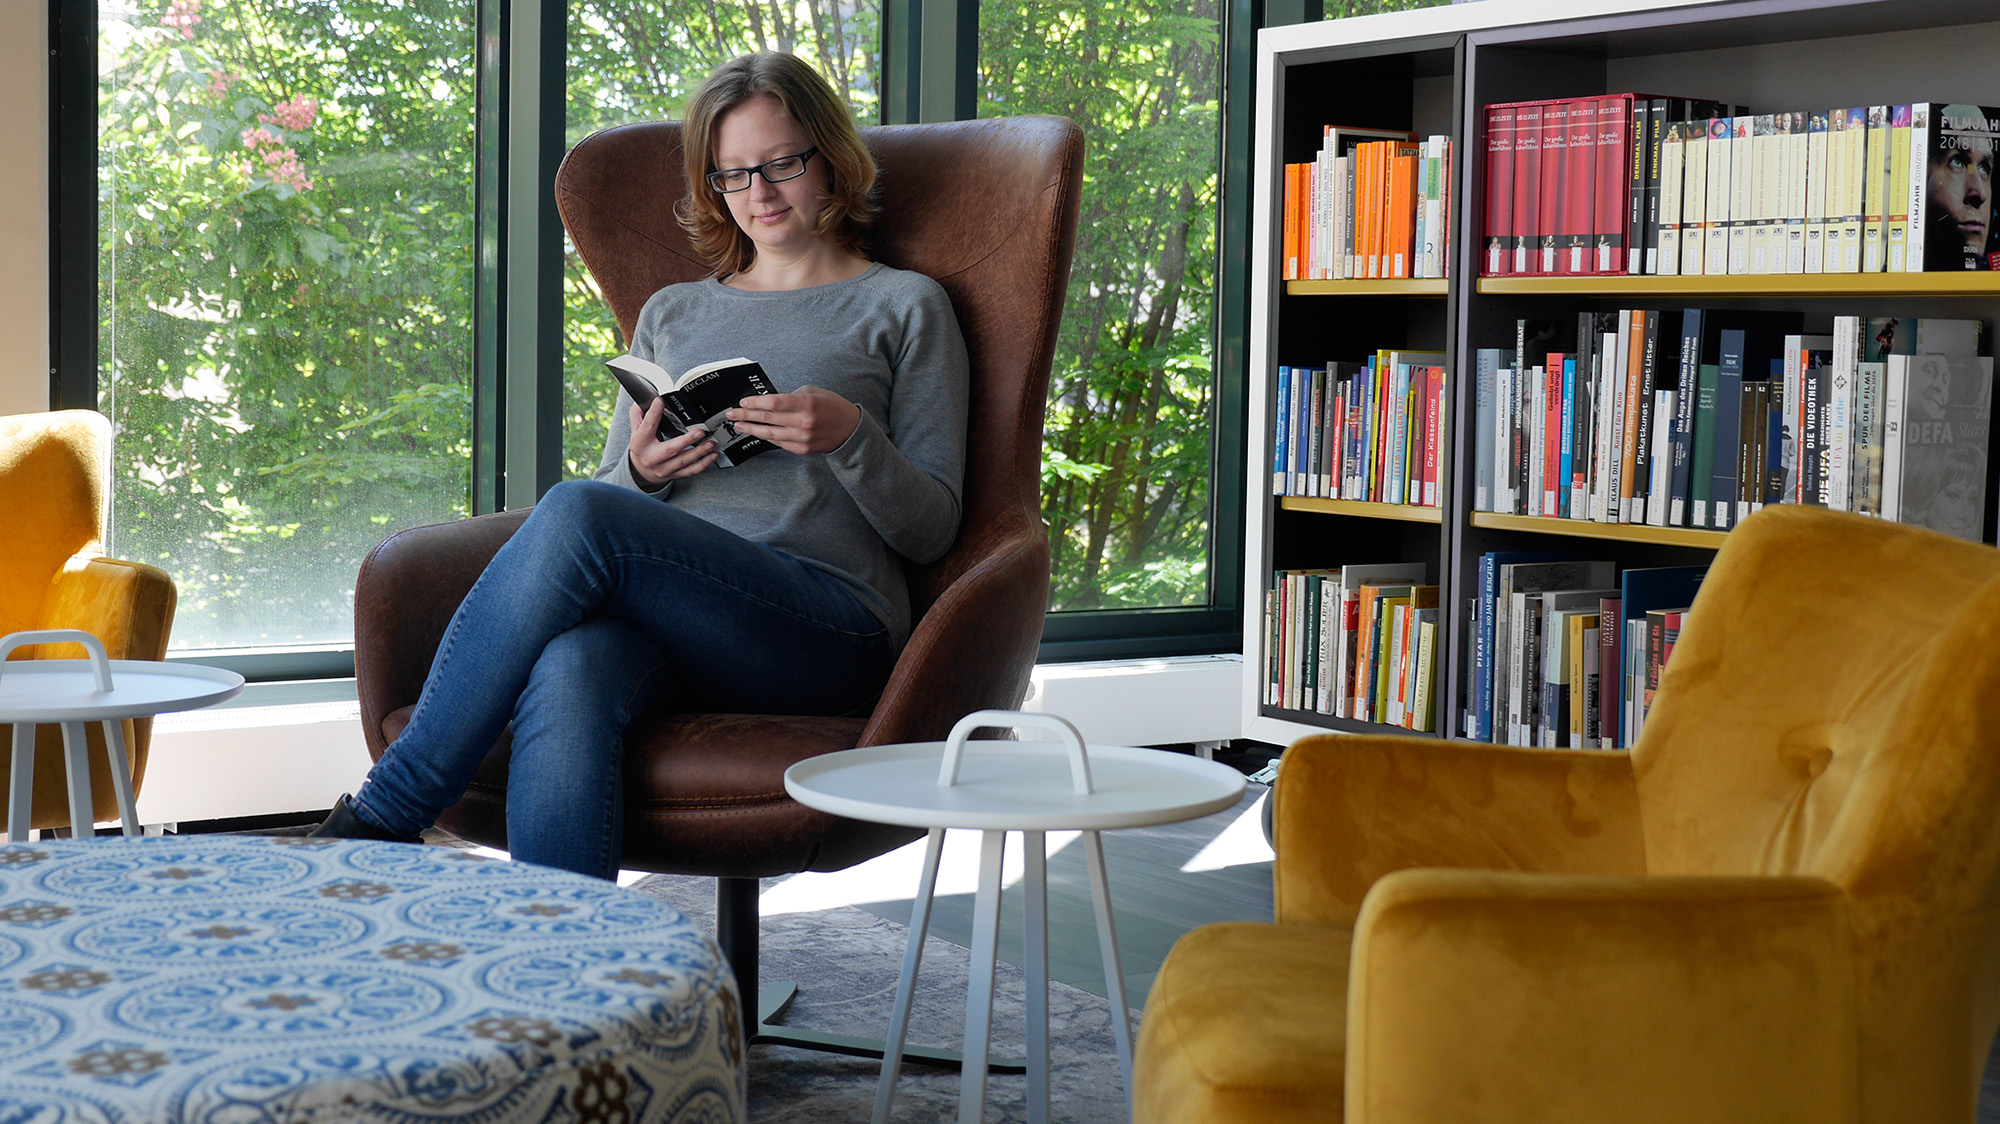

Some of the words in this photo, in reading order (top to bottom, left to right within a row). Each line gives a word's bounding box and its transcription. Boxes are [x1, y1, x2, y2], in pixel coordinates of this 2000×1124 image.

[1942, 116, 2000, 131] FILMJAH
[1682, 337, 1690, 362] Reiches
[1517, 358, 1523, 366] IM
[683, 372, 720, 392] RECLAM
[1642, 369, 1651, 395] Ernst
[1680, 365, 1688, 386] Dritten
[1863, 371, 1871, 399] FILME
[1553, 371, 1561, 405] verdrängt
[1615, 392, 1623, 407] Kino
[1626, 376, 1637, 433] Filmplakate
[1808, 378, 1816, 429] VIDEOTHEK
[1614, 410, 1622, 425] fürs
[1835, 397, 1844, 428] Farbe
[1428, 399, 1436, 450] Klassenfeind
[1637, 403, 1648, 464] Plakatkunst
[1908, 422, 1953, 444] DEFA
[1613, 429, 1621, 449] Kunst
[1624, 436, 1634, 458] 700
[1807, 433, 1815, 448] DIE
[1834, 432, 1843, 443] in
[1819, 449, 1829, 477] UFA
[1834, 447, 1842, 469] UFA
[1819, 480, 1829, 503] DIE
